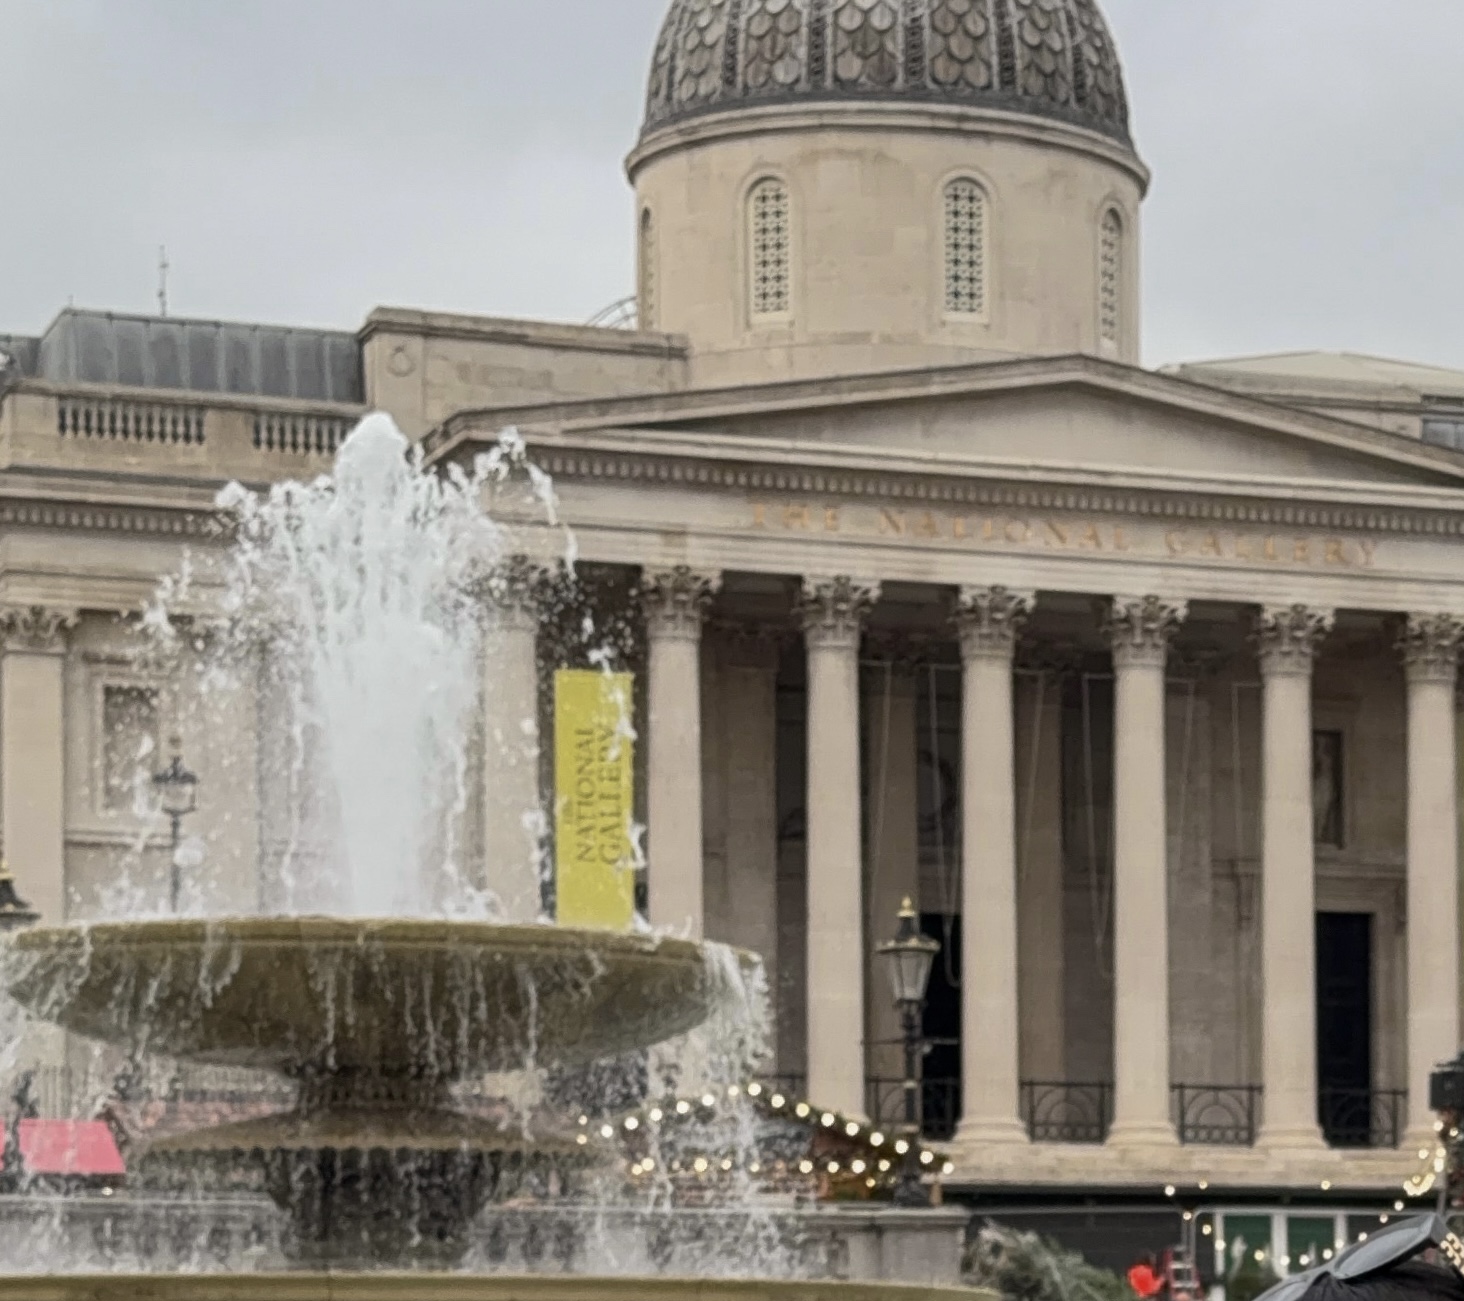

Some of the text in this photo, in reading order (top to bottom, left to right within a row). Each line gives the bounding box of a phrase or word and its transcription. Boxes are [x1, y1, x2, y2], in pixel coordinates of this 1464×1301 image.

[753, 503, 1376, 569] THE NATIONAL GALLERY
[575, 726, 596, 864] NATIONAL
